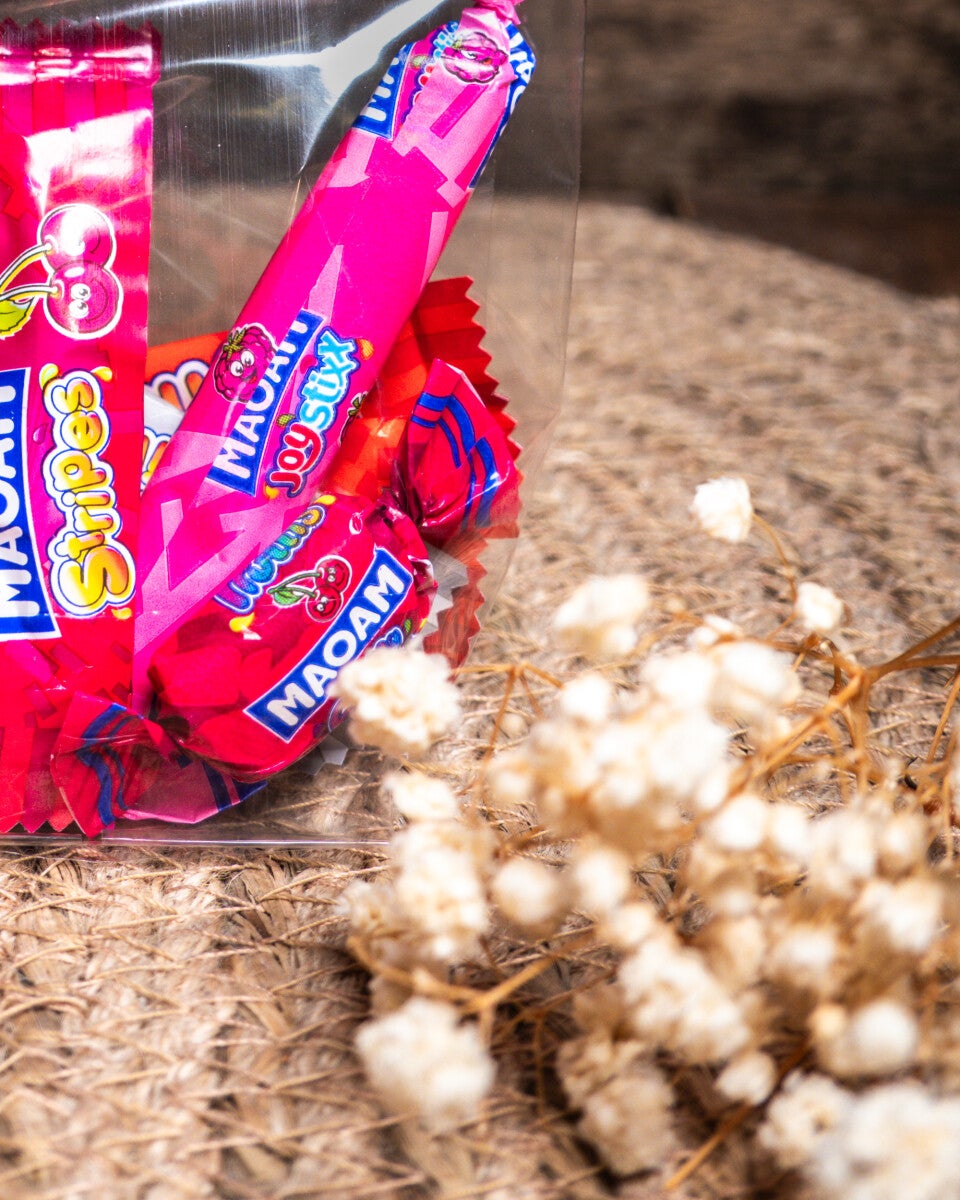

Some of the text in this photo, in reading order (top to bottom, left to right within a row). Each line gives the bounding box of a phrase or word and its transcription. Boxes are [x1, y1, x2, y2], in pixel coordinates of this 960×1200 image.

[44, 371, 133, 613] Stripes
[268, 328, 358, 496] Joystixx
[266, 563, 405, 726] MAOAM
